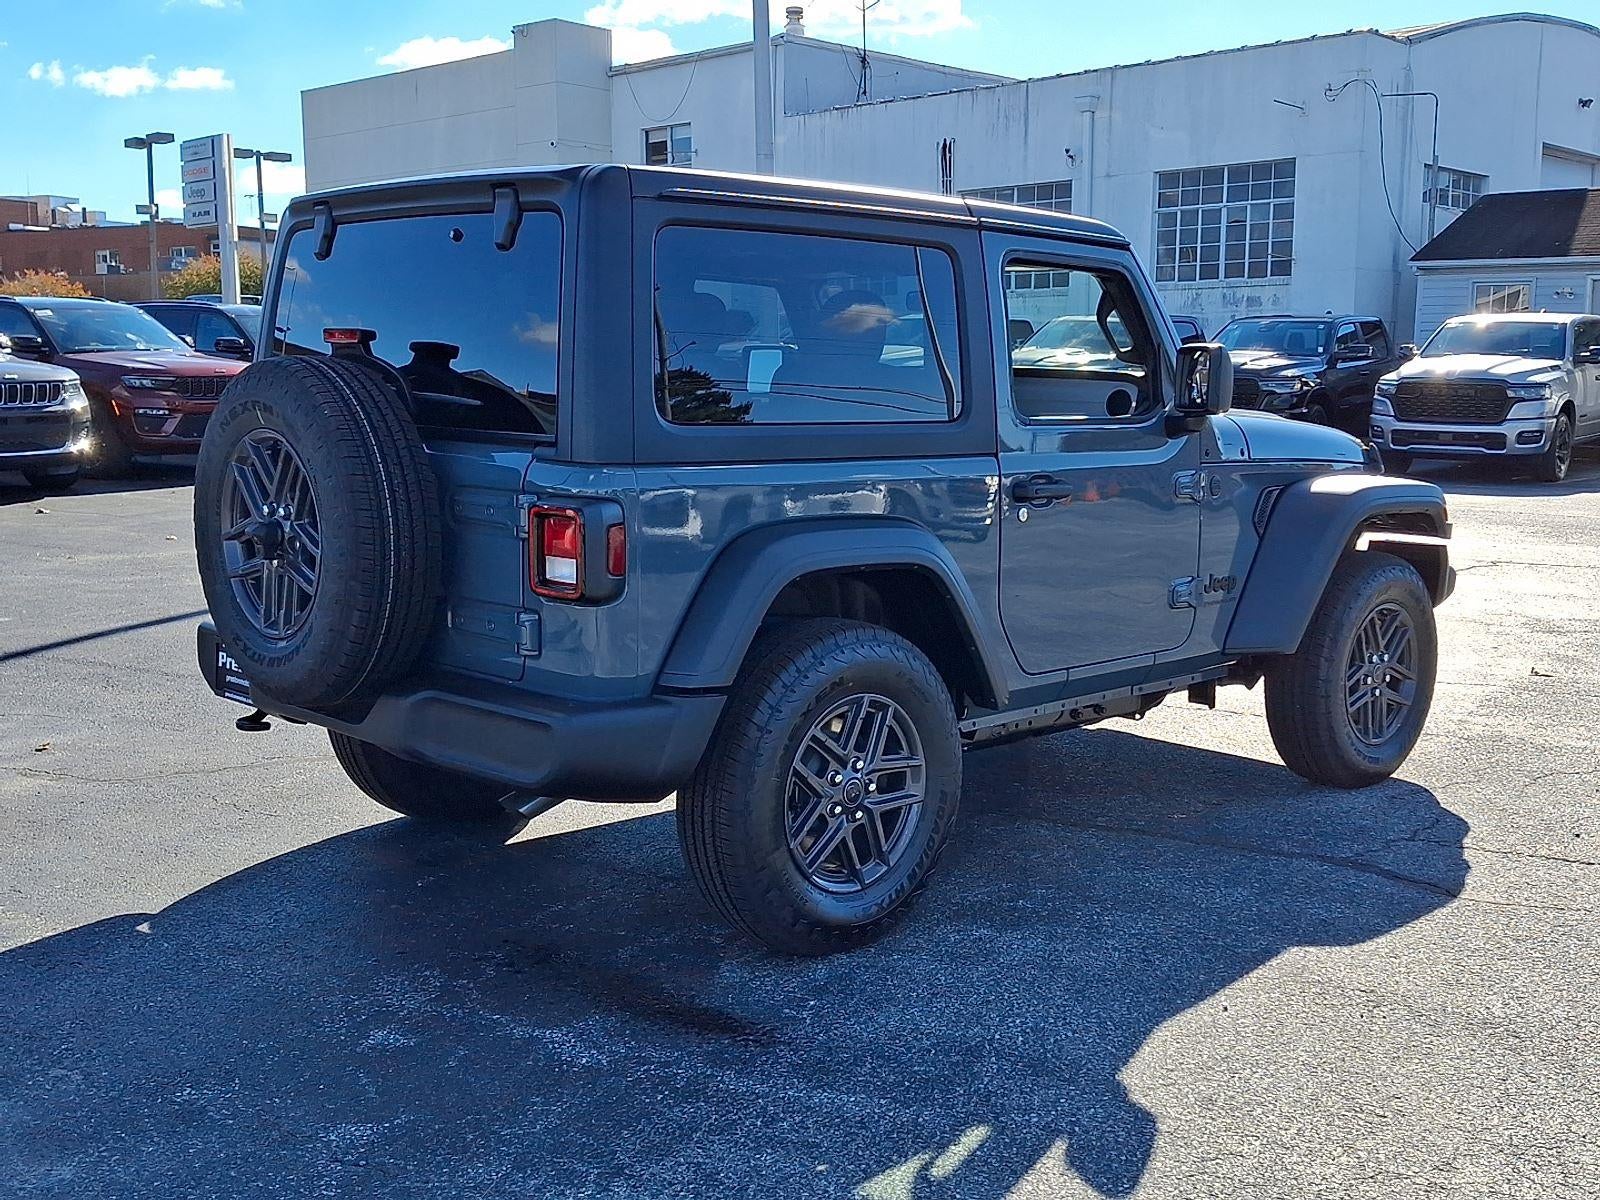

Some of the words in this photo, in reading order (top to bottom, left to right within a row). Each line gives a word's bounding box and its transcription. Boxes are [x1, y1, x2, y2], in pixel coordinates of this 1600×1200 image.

[188, 187, 205, 199] Jeep
[220, 400, 275, 433] NEXEN
[1203, 573, 1237, 595] Jeep
